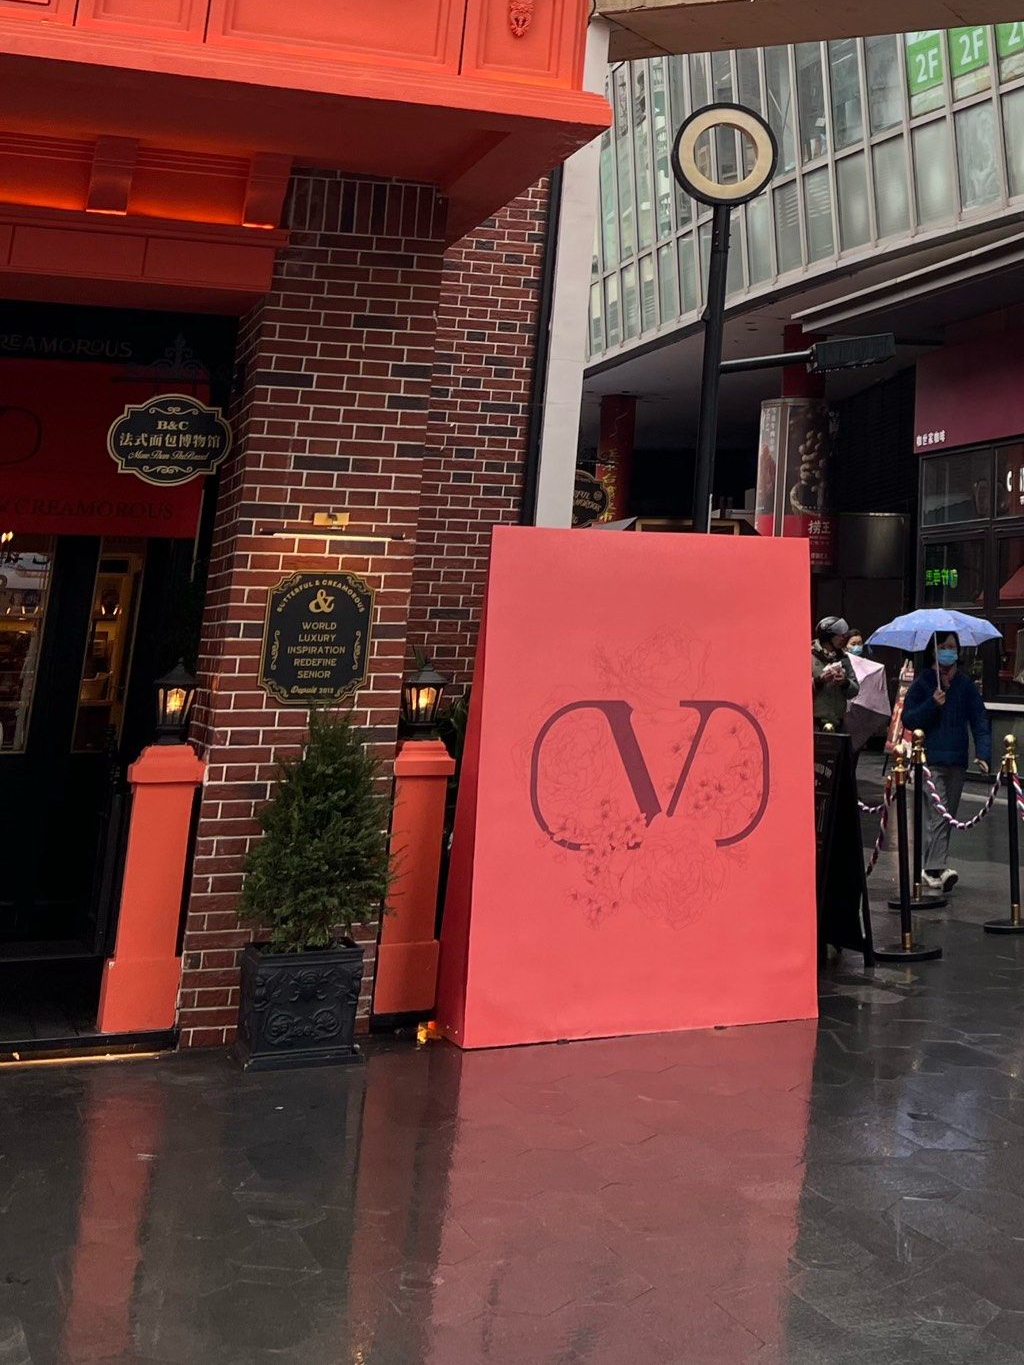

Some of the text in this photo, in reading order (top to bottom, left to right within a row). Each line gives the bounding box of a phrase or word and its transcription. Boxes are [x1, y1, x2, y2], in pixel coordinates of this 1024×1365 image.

[959, 28, 983, 66] 2F
[915, 47, 938, 84] 2F
[156, 420, 190, 431] B&C
[119, 432, 221, 449] 法式面包博物馆
[808, 519, 831, 535] 捞王
[302, 622, 337, 630] WORLD
[298, 634, 337, 642] LUXURY
[287, 646, 346, 654] INSPIRATION
[293, 658, 337, 666] REDEFINE
[297, 670, 331, 678] SENIOR
